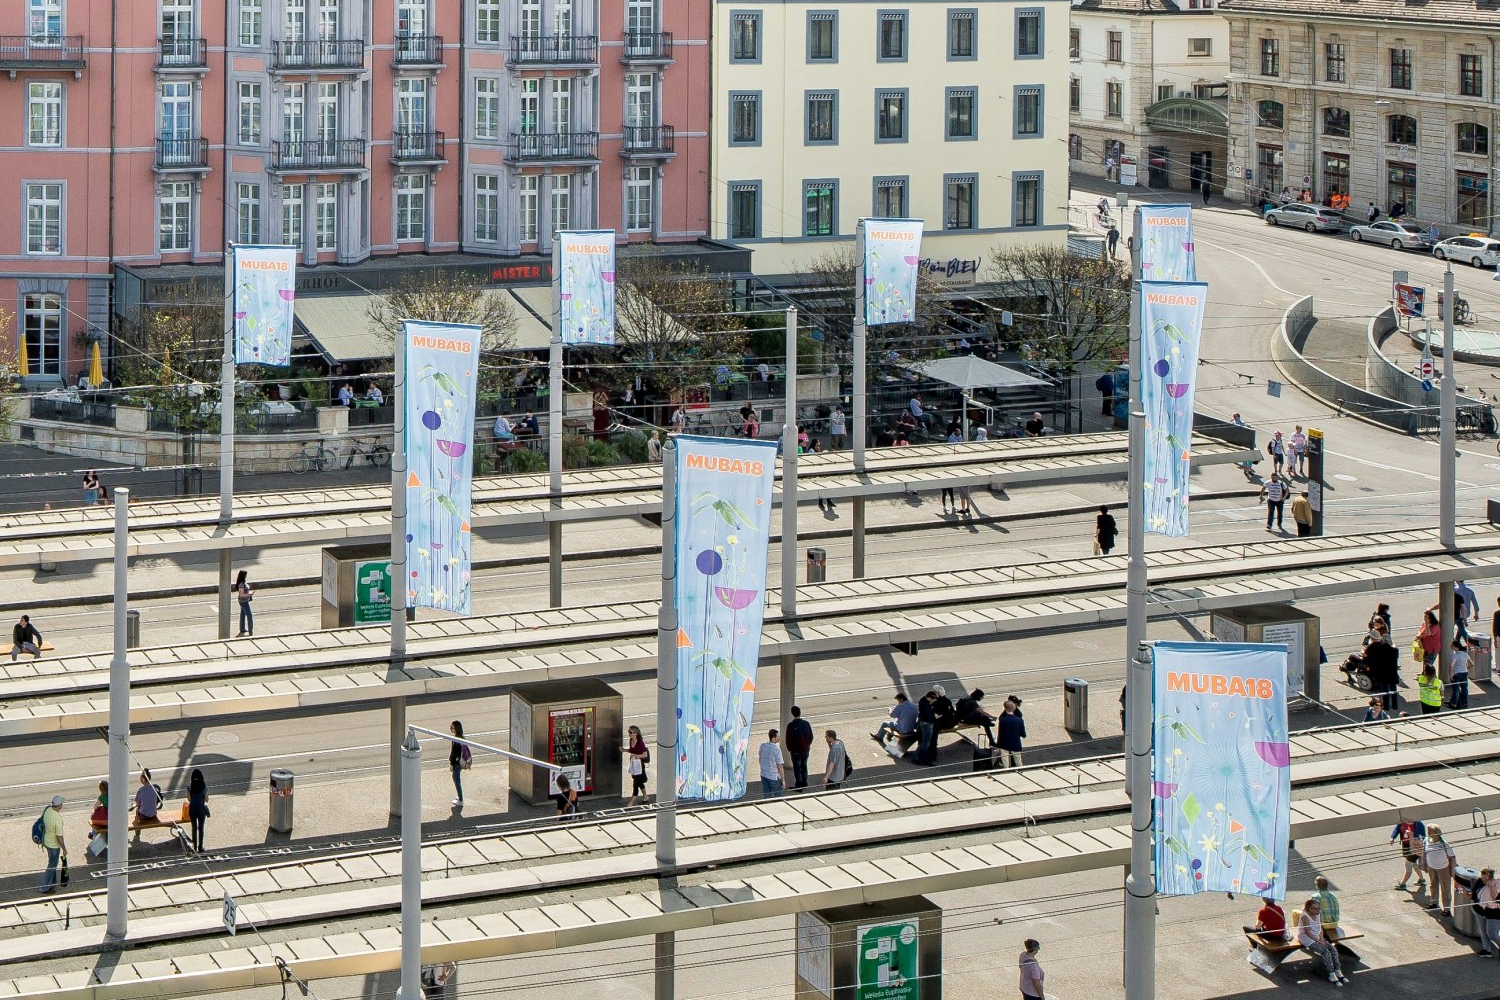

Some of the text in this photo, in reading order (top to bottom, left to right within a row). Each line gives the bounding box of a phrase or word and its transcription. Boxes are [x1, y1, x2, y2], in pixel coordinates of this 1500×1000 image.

[1146, 216, 1187, 228] MUBA18
[870, 230, 916, 241] MUBA18
[566, 244, 609, 255] MUBA18
[240, 259, 288, 271] MUBA18
[491, 266, 540, 281] MISTER
[1146, 293, 1198, 307] MUBA18
[412, 335, 472, 354] MUBA18
[686, 453, 764, 476] MUBA18
[1166, 671, 1274, 701] MUBA18
[224, 900, 235, 928] 25
[864, 990, 885, 1000] Weleda
